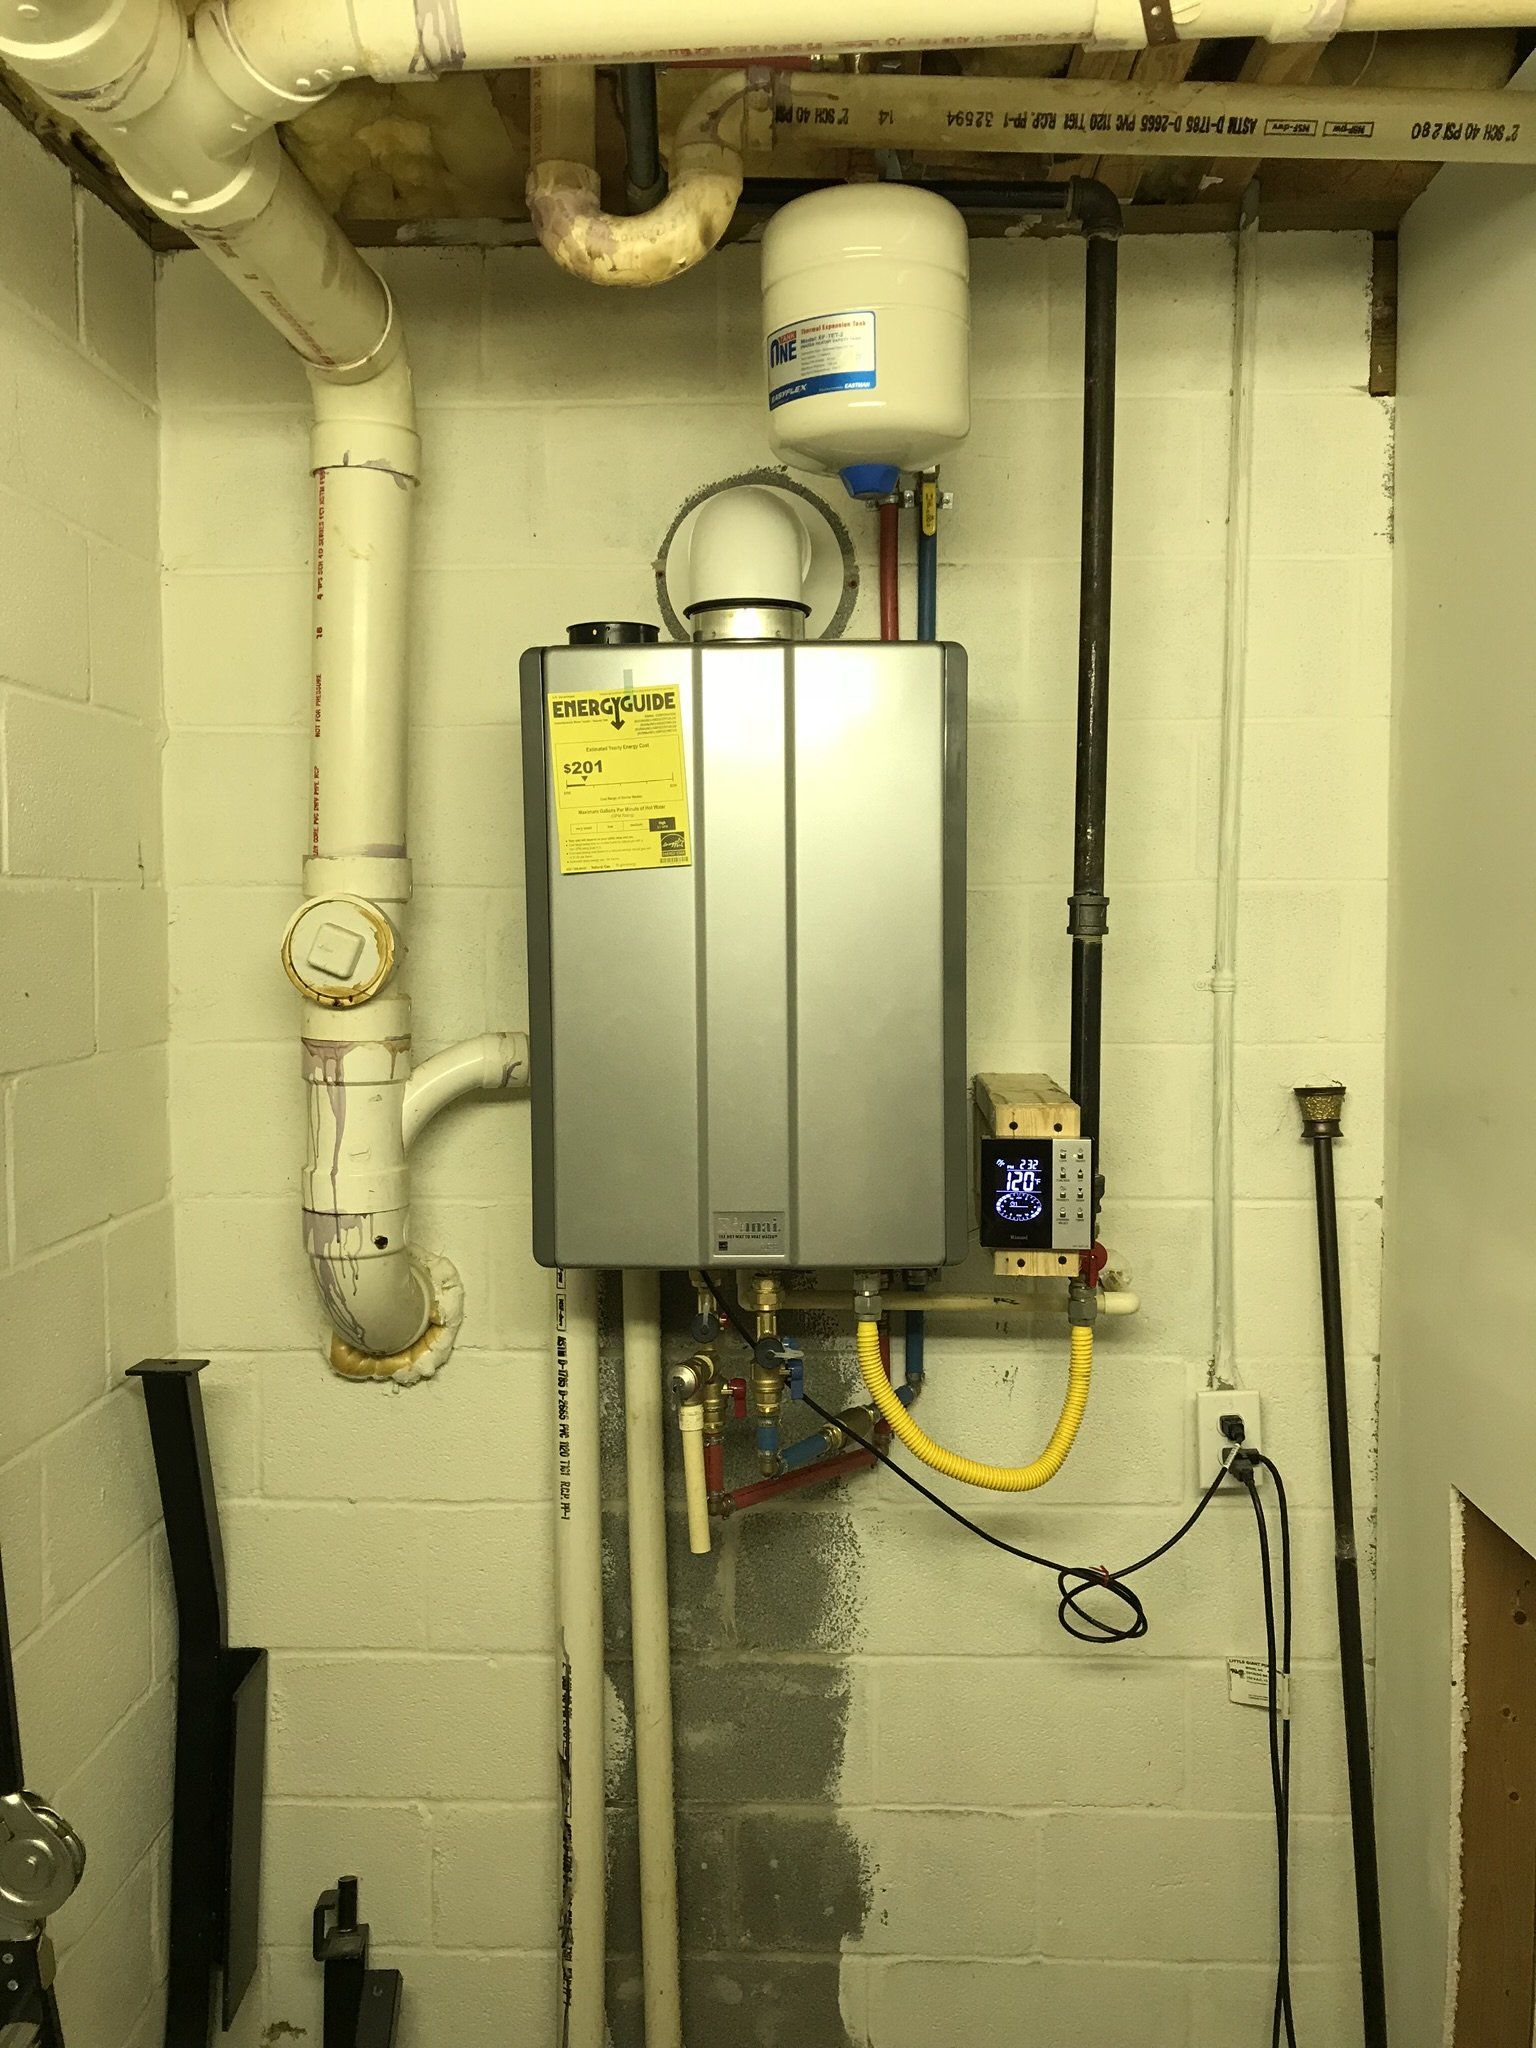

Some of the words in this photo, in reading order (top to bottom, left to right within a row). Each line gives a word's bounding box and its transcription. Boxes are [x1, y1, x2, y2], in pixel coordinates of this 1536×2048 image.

[796, 106, 810, 124] 40
[814, 108, 836, 125] SCH
[878, 109, 894, 126] 14
[1003, 111, 1028, 129] PP-1
[1090, 112, 1112, 131] 1120
[1116, 114, 1136, 132] PVC
[1140, 114, 1182, 133] D-2665
[1186, 114, 1226, 134] D-1785
[1227, 116, 1258, 136] ASTM
[1412, 122, 1441, 140] 280
[1442, 122, 1462, 141] PSI
[1465, 124, 1480, 140] 40
[1482, 124, 1505, 142] SCH
[552, 692, 676, 719] ENERGYGUIDE
[563, 760, 603, 774] $201
[1006, 1171, 1035, 1192] 120
[558, 1336, 567, 1357] ASTM
[558, 1359, 568, 1388] D-1785
[558, 1390, 570, 1420] D-2665
[559, 1424, 570, 1438] PVC
[559, 1441, 570, 1458] 1120
[560, 1502, 571, 1520] PP-1
